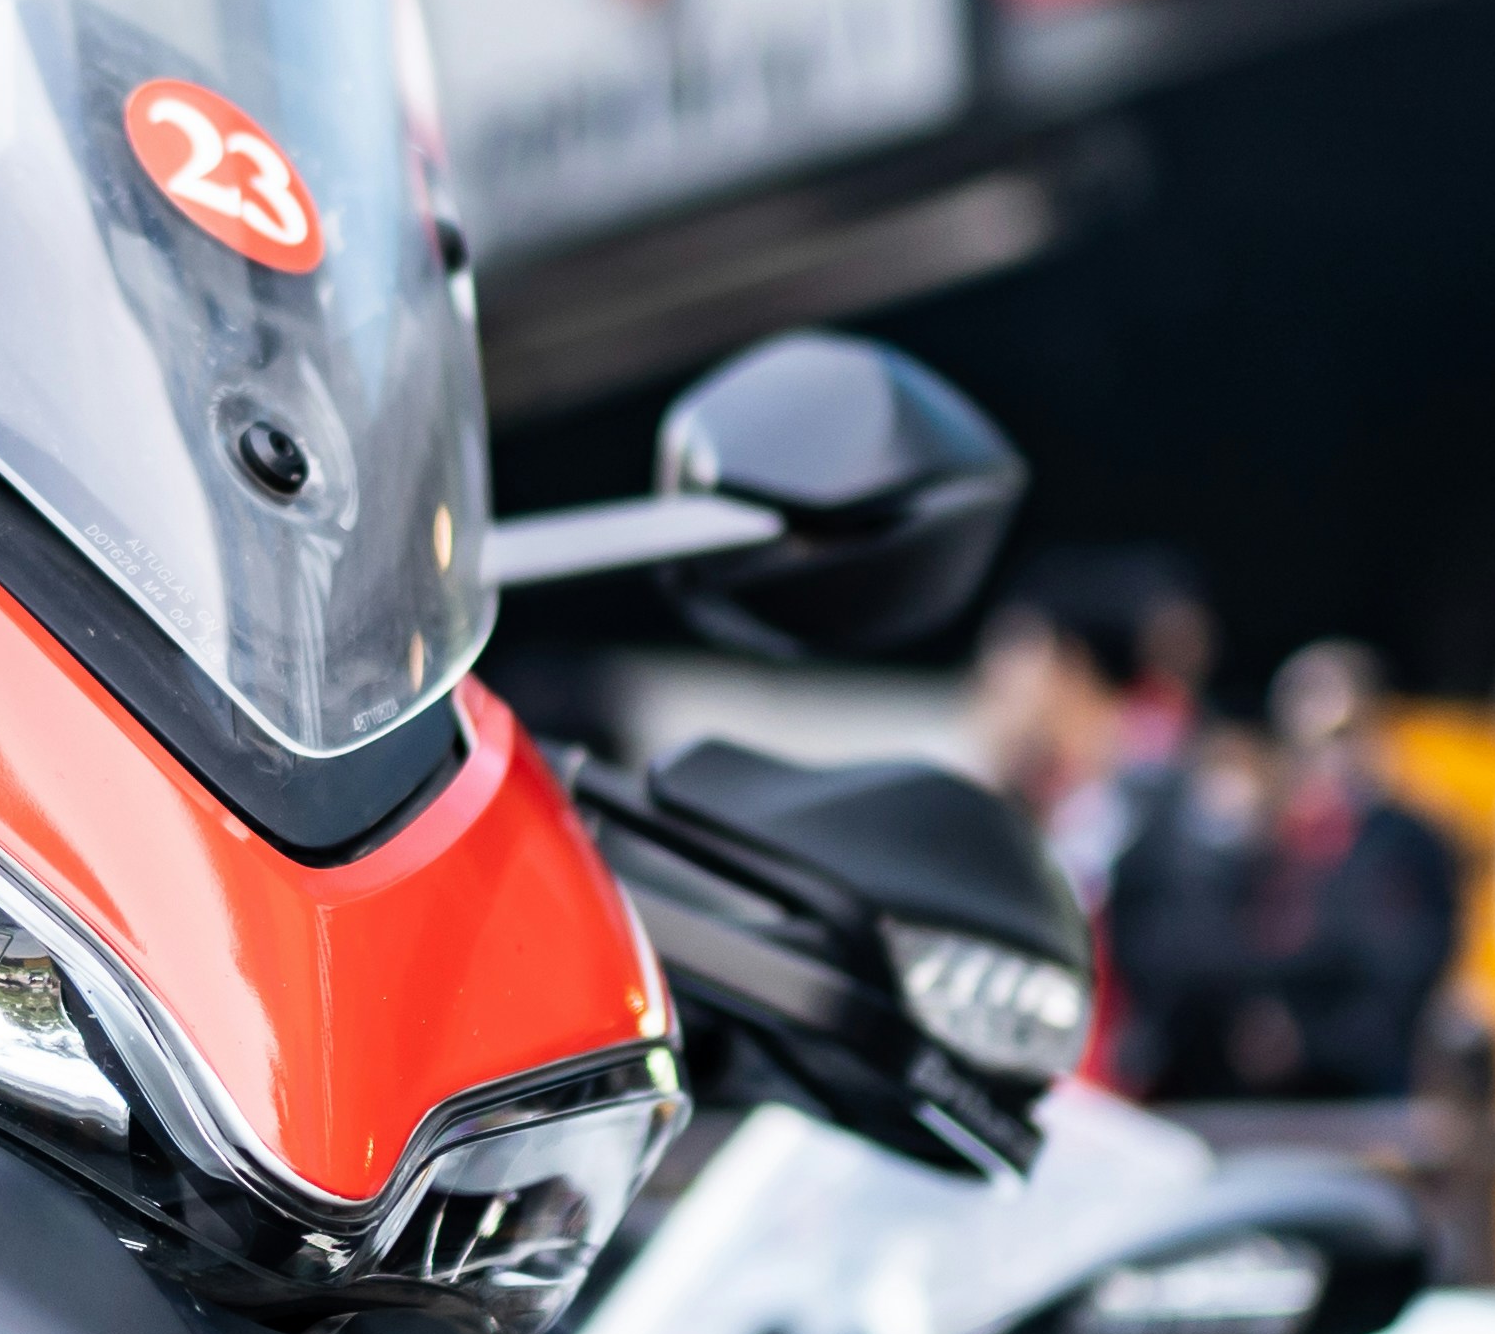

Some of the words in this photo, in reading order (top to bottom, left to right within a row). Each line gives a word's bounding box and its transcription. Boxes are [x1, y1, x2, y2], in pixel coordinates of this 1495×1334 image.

[147, 97, 309, 246] 23
[84, 524, 141, 576] DOT626
[125, 538, 195, 604] ALTUGLAS
